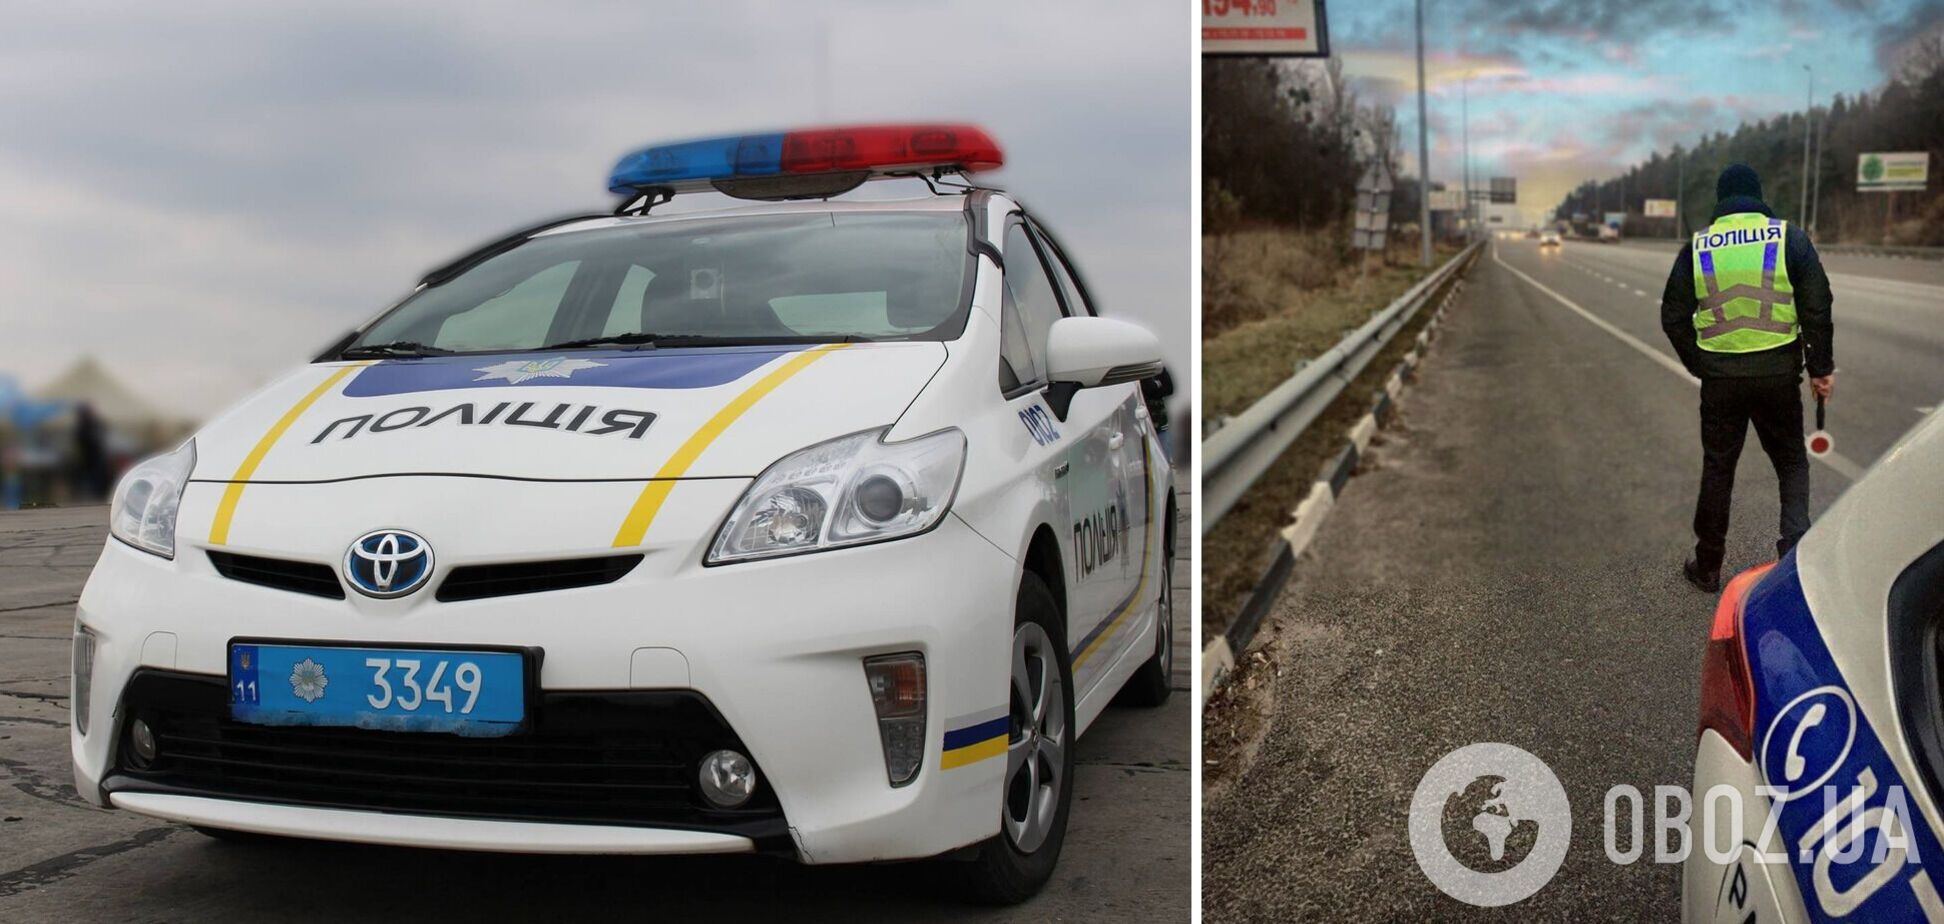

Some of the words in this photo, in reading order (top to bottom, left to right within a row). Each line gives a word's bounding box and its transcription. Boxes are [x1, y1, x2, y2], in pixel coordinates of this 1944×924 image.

[1695, 226, 1782, 250] ПОЛІЦІЯ
[310, 401, 658, 445] ПОЛІЦІЯ
[236, 680, 257, 702] 11
[365, 657, 482, 714] 3349
